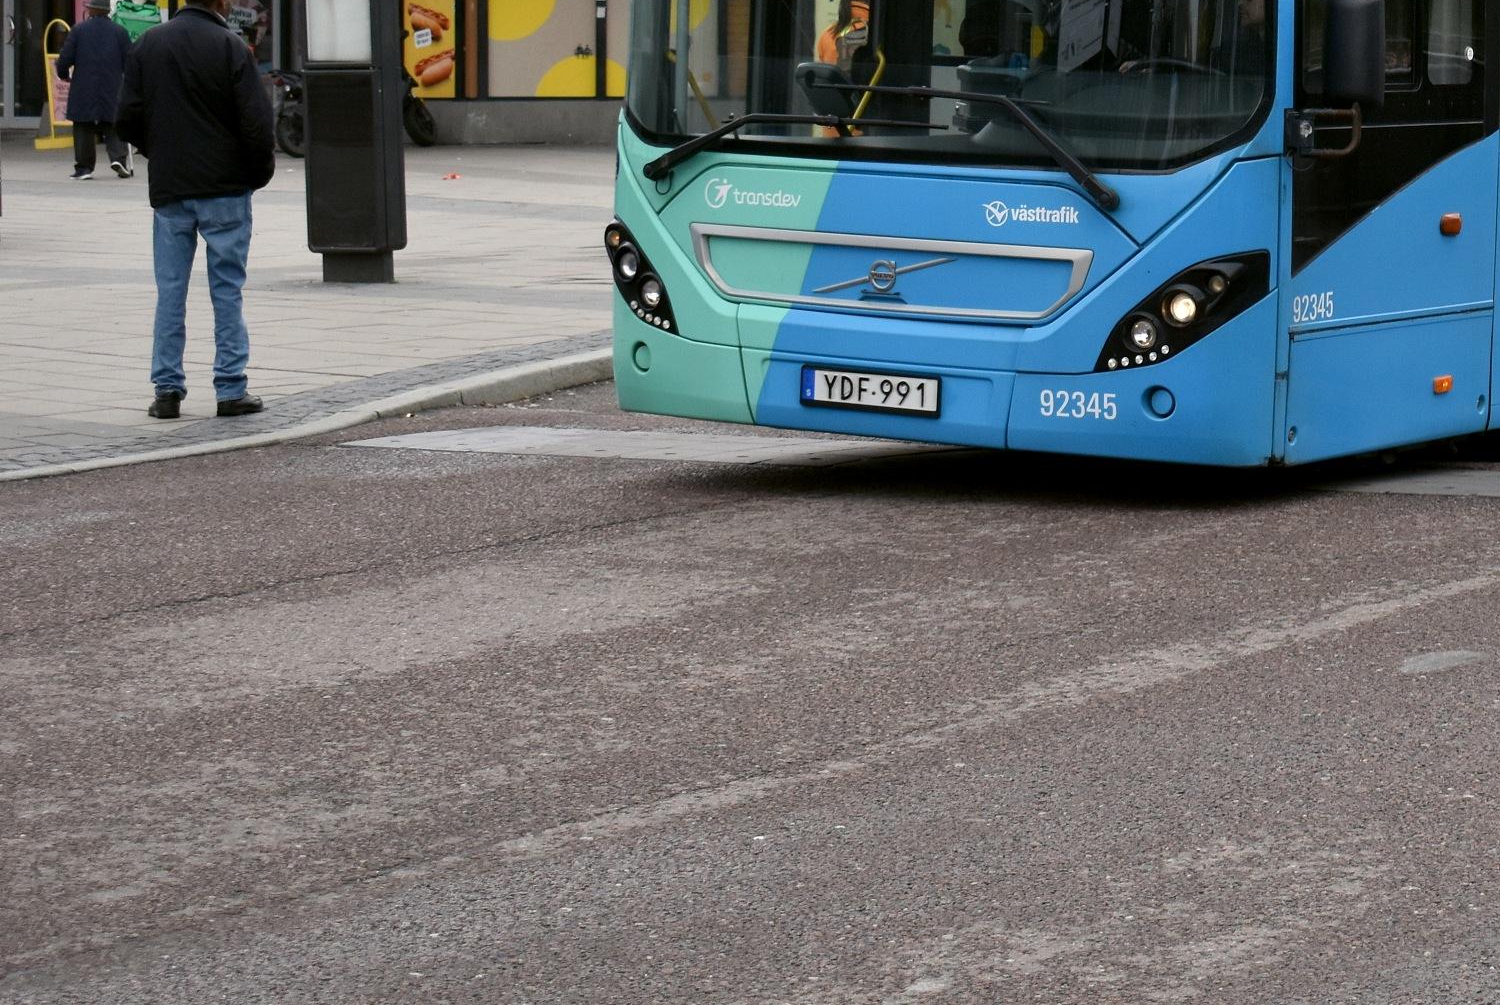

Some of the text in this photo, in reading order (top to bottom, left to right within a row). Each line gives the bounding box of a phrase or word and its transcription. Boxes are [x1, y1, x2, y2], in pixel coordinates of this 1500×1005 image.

[732, 188, 801, 207] transdev
[1011, 204, 1079, 224] västtrafik
[1293, 291, 1334, 323] 92345
[1039, 389, 1118, 420] 92345
